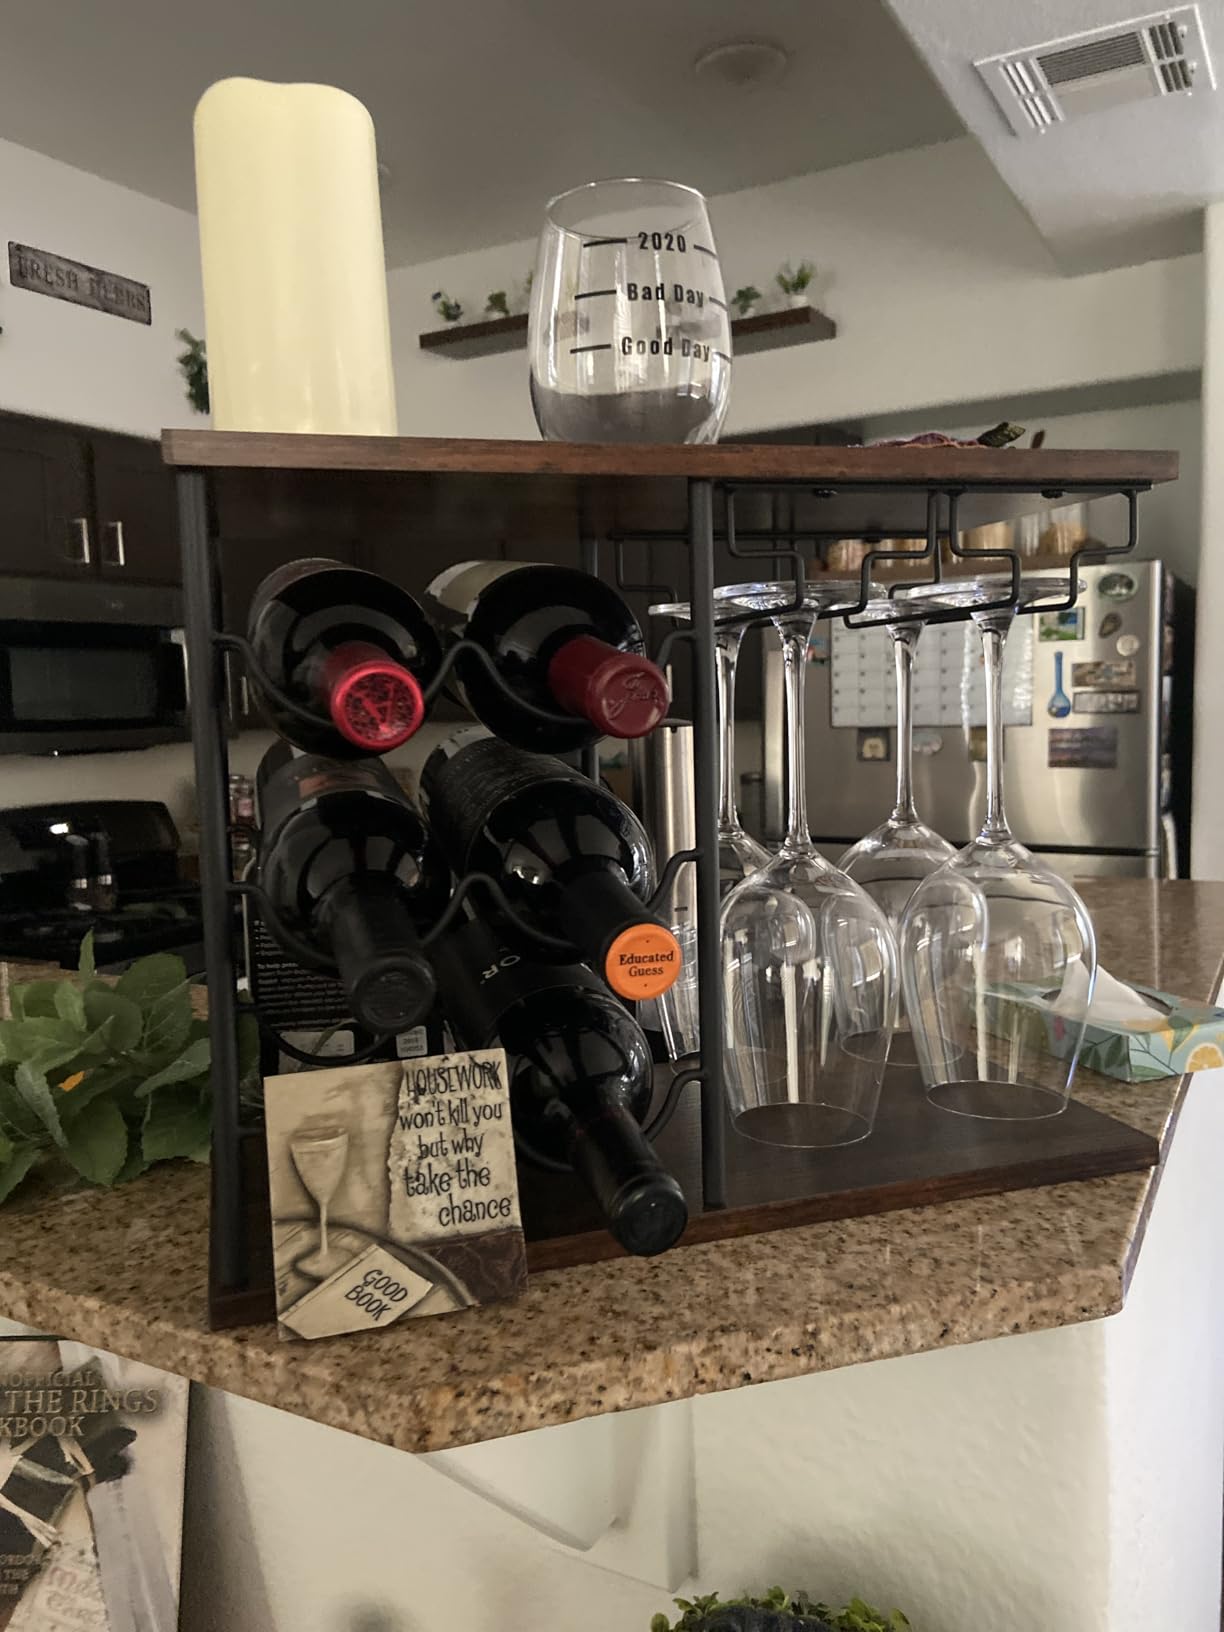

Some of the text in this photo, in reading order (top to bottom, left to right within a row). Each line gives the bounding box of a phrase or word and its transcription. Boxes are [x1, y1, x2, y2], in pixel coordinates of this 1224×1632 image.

[638, 232, 687, 253] 2020
[627, 283, 704, 308] Bad Day
[621, 336, 710, 362] Good Day
[619, 951, 674, 966] Educated
[628, 966, 664, 977] Guess
[406, 1061, 503, 1097] HOUSEWORK
[400, 1097, 503, 1131] won't kill you
[418, 1128, 485, 1159] but why
[404, 1158, 491, 1197] take the
[439, 1193, 512, 1227] chance
[363, 1269, 408, 1302] GOOD
[344, 1285, 392, 1321] BOOK
[4, 1388, 158, 1414] THE RINGS
